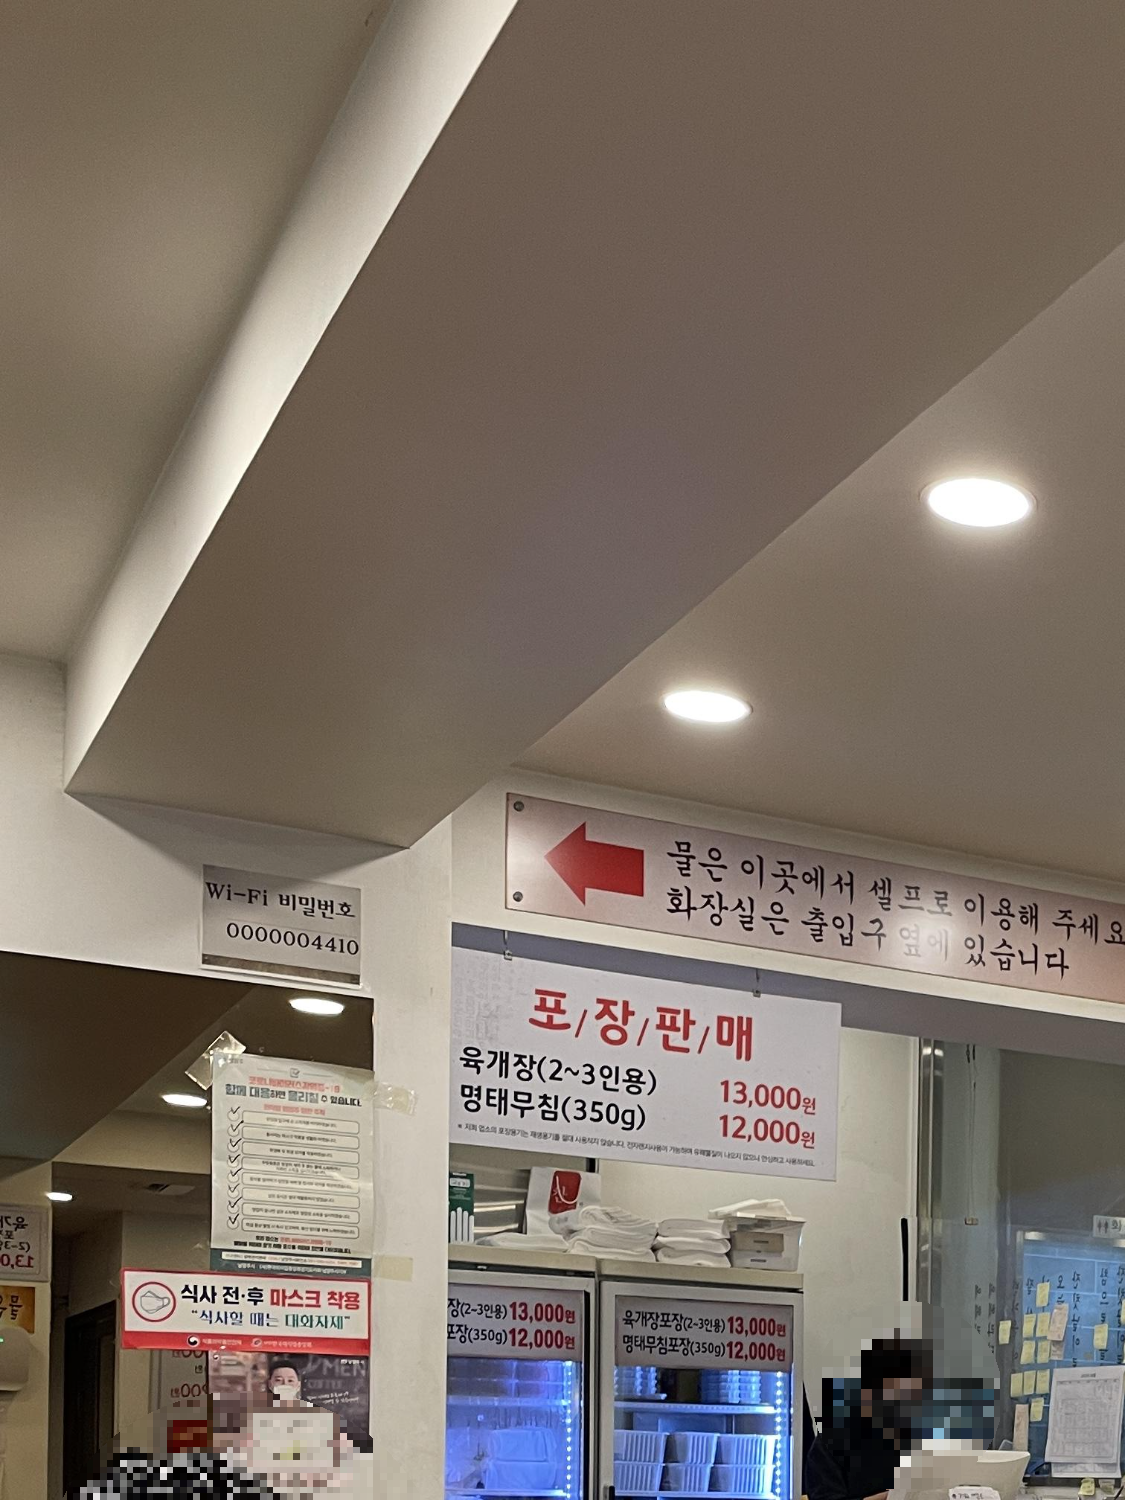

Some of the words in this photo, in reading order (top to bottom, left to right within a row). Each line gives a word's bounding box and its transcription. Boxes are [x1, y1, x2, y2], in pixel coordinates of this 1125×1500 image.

[205, 881, 268, 907] Wi-Fi
[278, 893, 356, 920] 비밀번호
[667, 840, 727, 878] 물은
[739, 853, 855, 906] 이곳에서
[867, 878, 952, 918] 셀프로
[964, 893, 1040, 937] 이용해
[226, 921, 360, 956] 0000004410
[667, 886, 790, 936] 화장실은
[801, 906, 888, 951] 출입구
[899, 923, 950, 962] 옆에
[964, 934, 1070, 973] 있습니다
[459, 1046, 658, 1097] 육개장(2~3인용)
[719, 1080, 817, 1116] 13,000원
[460, 1085, 648, 1132] 명태무침(350g)
[718, 1113, 816, 1150] 12,000원
[180, 1284, 217, 1305] 식사
[270, 1288, 322, 1309] 마스크
[327, 1290, 360, 1311] 착용
[508, 1301, 576, 1325] 13,000원
[508, 1328, 576, 1351] 12,000원
[622, 1309, 726, 1335] 육개장포장(2~3인용)
[727, 1316, 787, 1338] 13,000원
[622, 1333, 727, 1358] 명태무침포장(350g)
[726, 1341, 787, 1363] 12,000원
